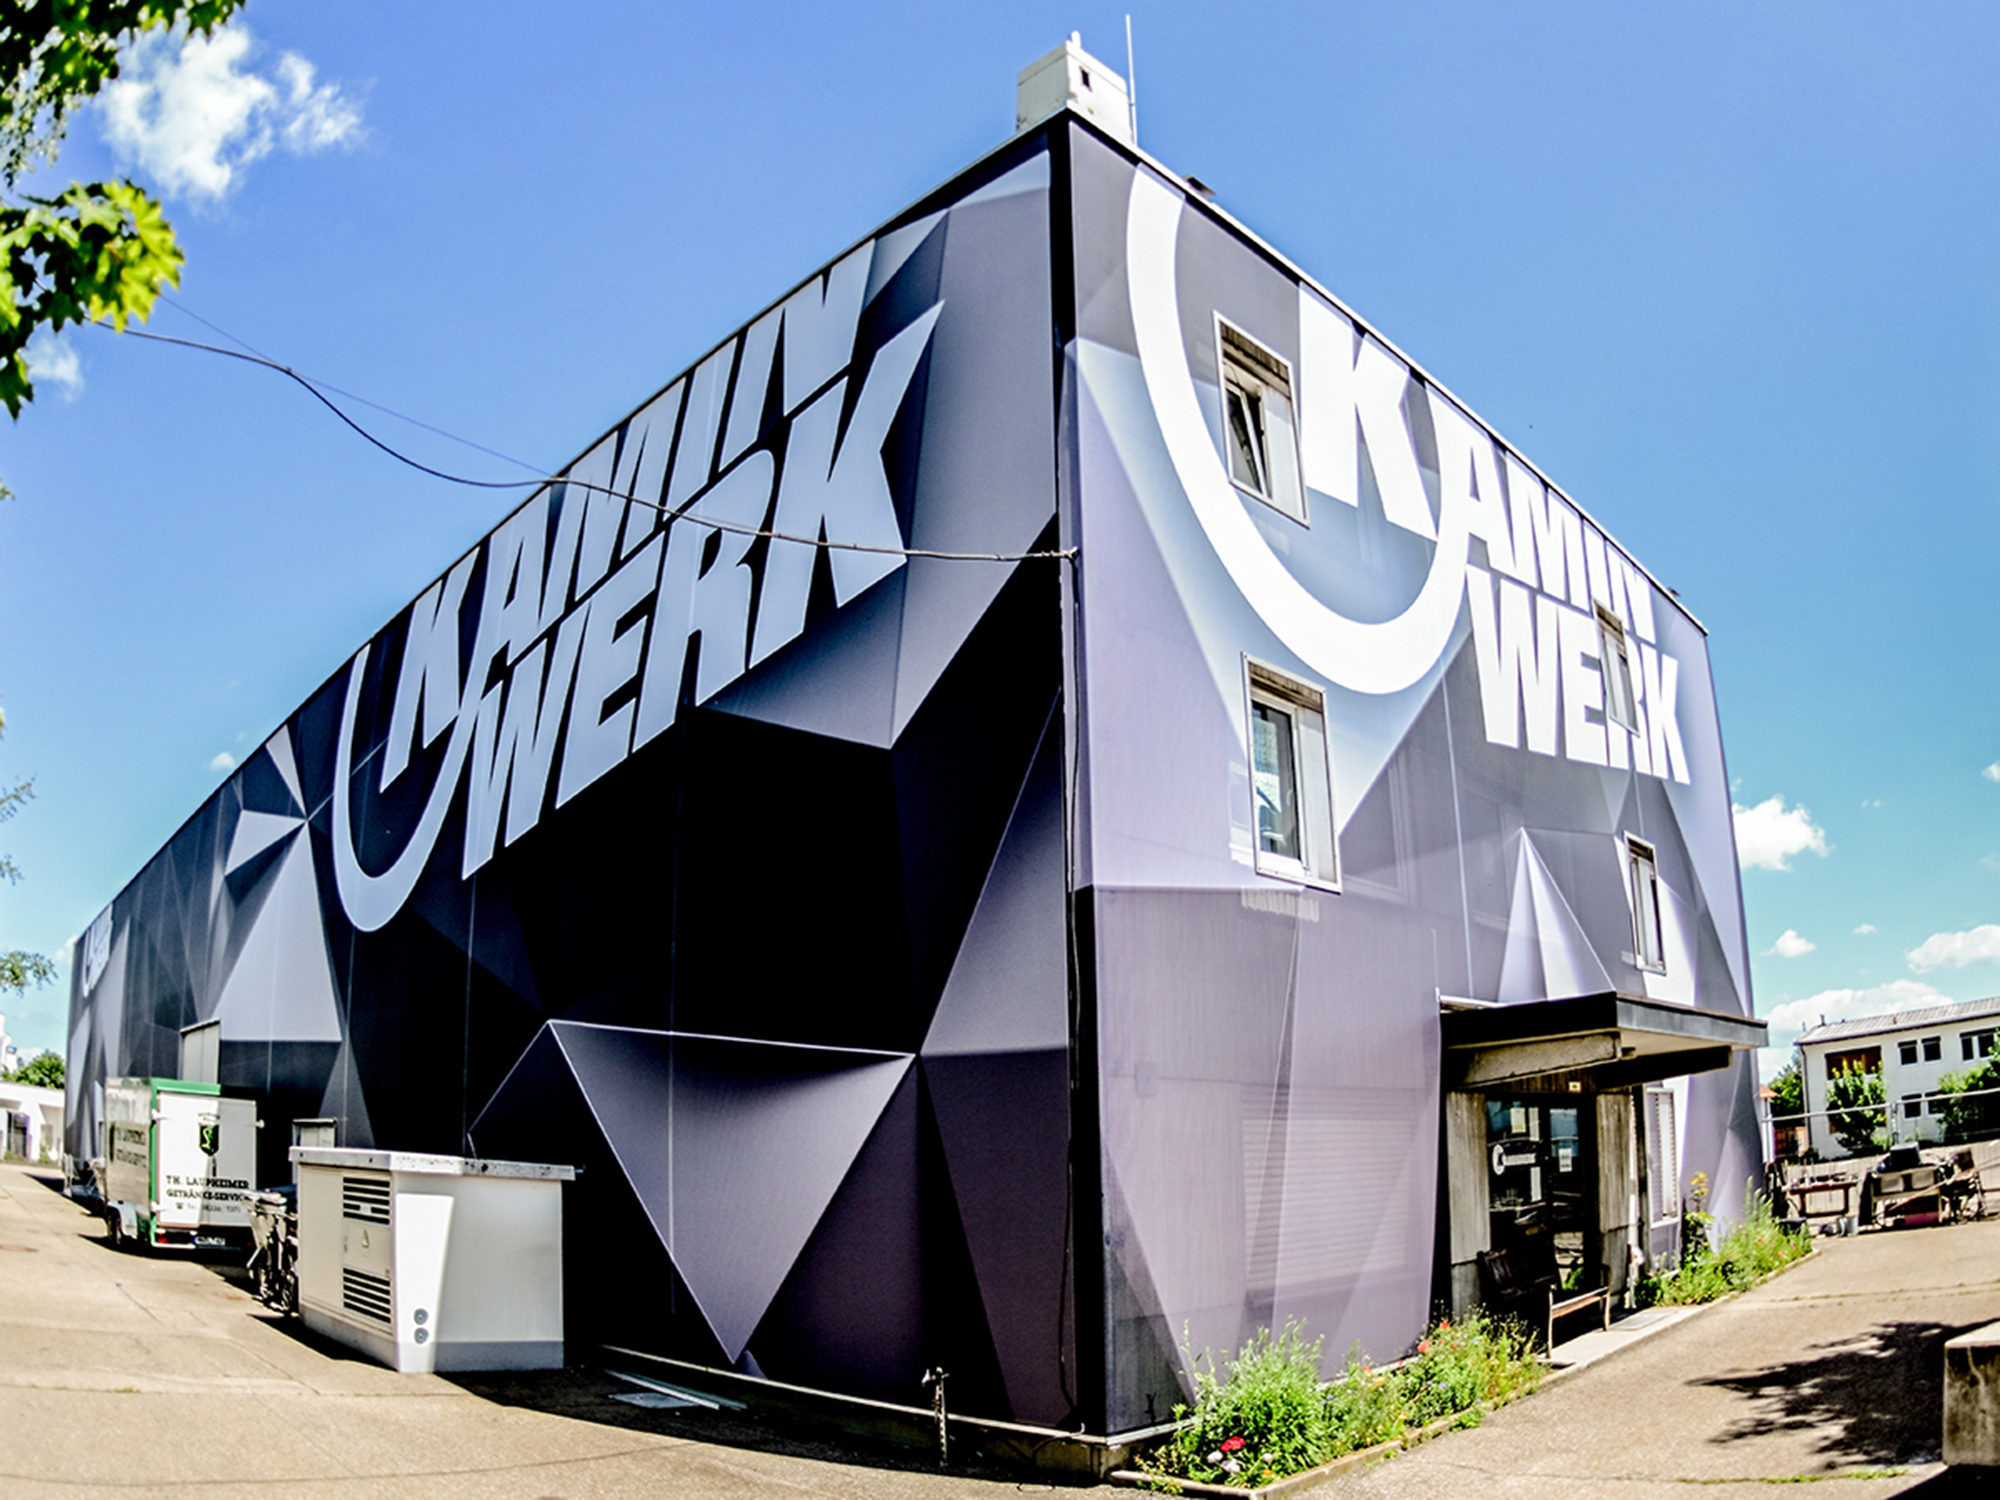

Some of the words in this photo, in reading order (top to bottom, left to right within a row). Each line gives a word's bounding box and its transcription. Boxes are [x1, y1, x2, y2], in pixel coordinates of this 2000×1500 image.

[378, 239, 875, 793] KAMIN
[462, 300, 945, 880] WERK
[1299, 279, 1657, 694] KAMIN
